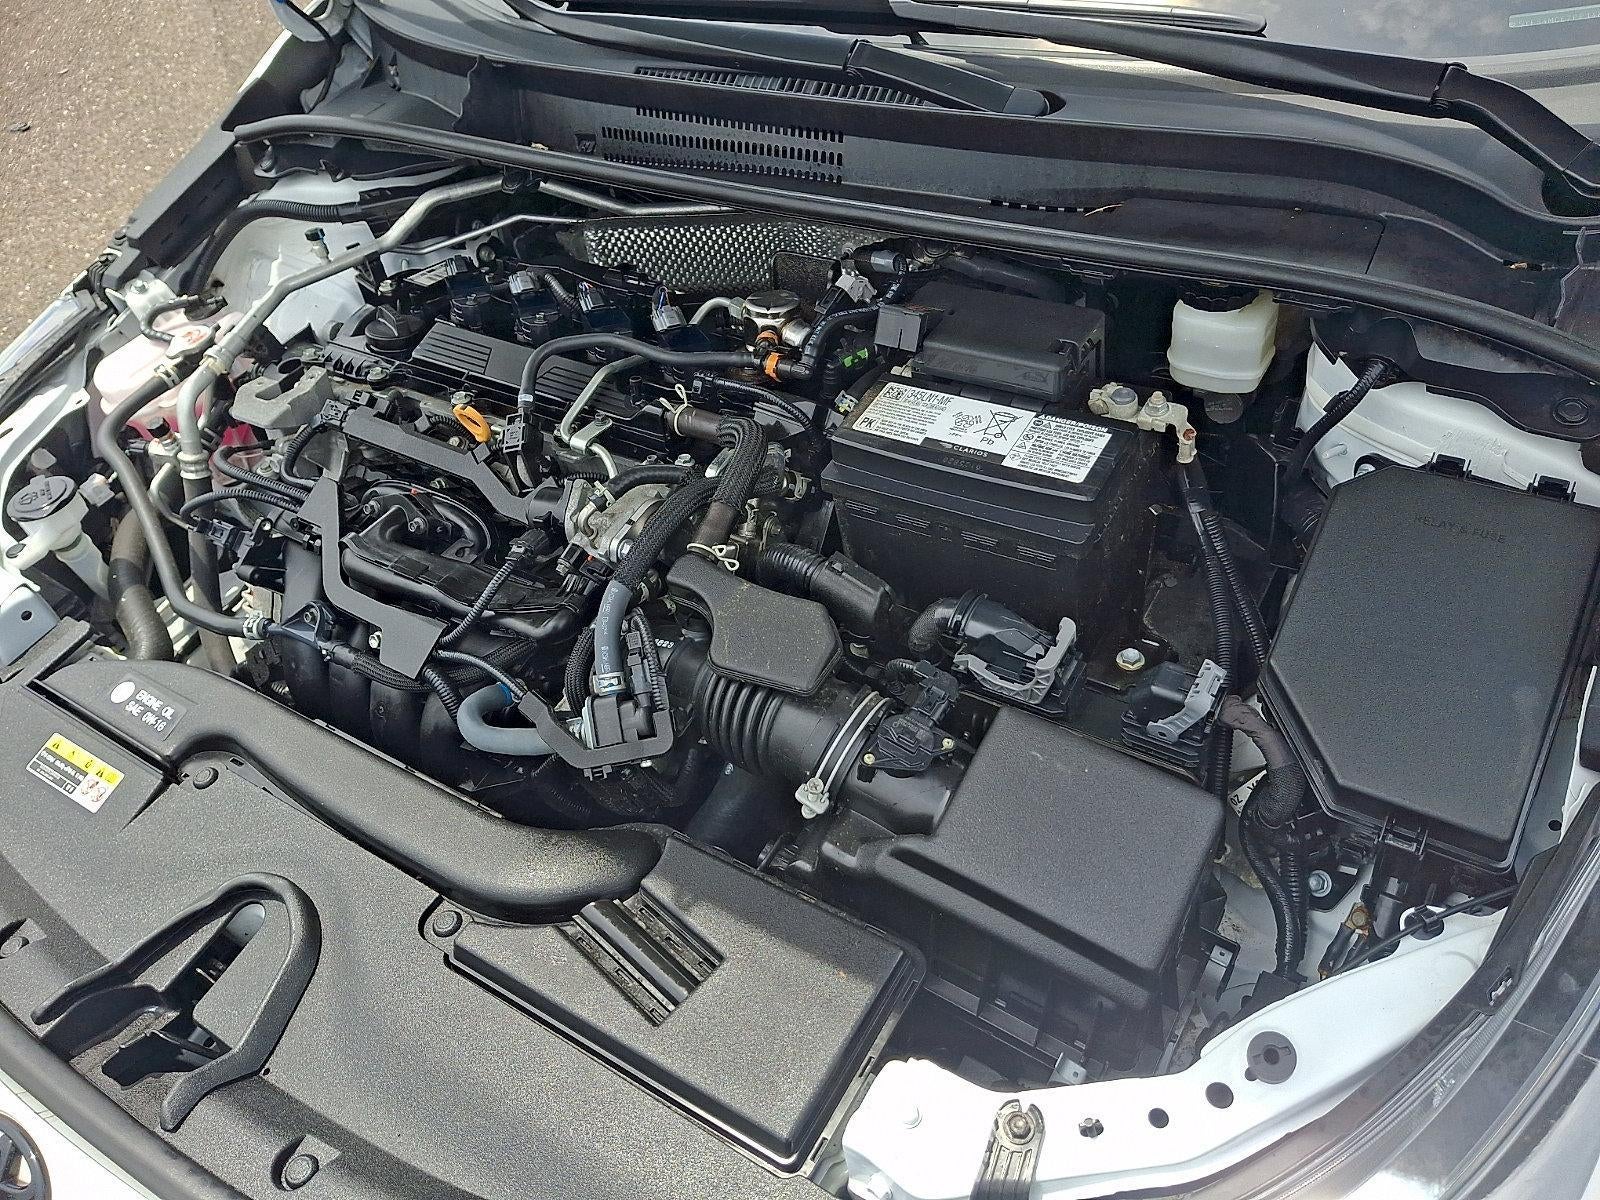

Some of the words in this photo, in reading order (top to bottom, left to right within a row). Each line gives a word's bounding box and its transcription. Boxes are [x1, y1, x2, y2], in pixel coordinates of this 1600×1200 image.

[860, 417, 876, 429] PK
[980, 437, 994, 445] Pb
[953, 445, 988, 457] CLARIOS
[1470, 526, 1507, 544] FUSE
[136, 689, 163, 711] ENGINE
[125, 701, 144, 716] SAE
